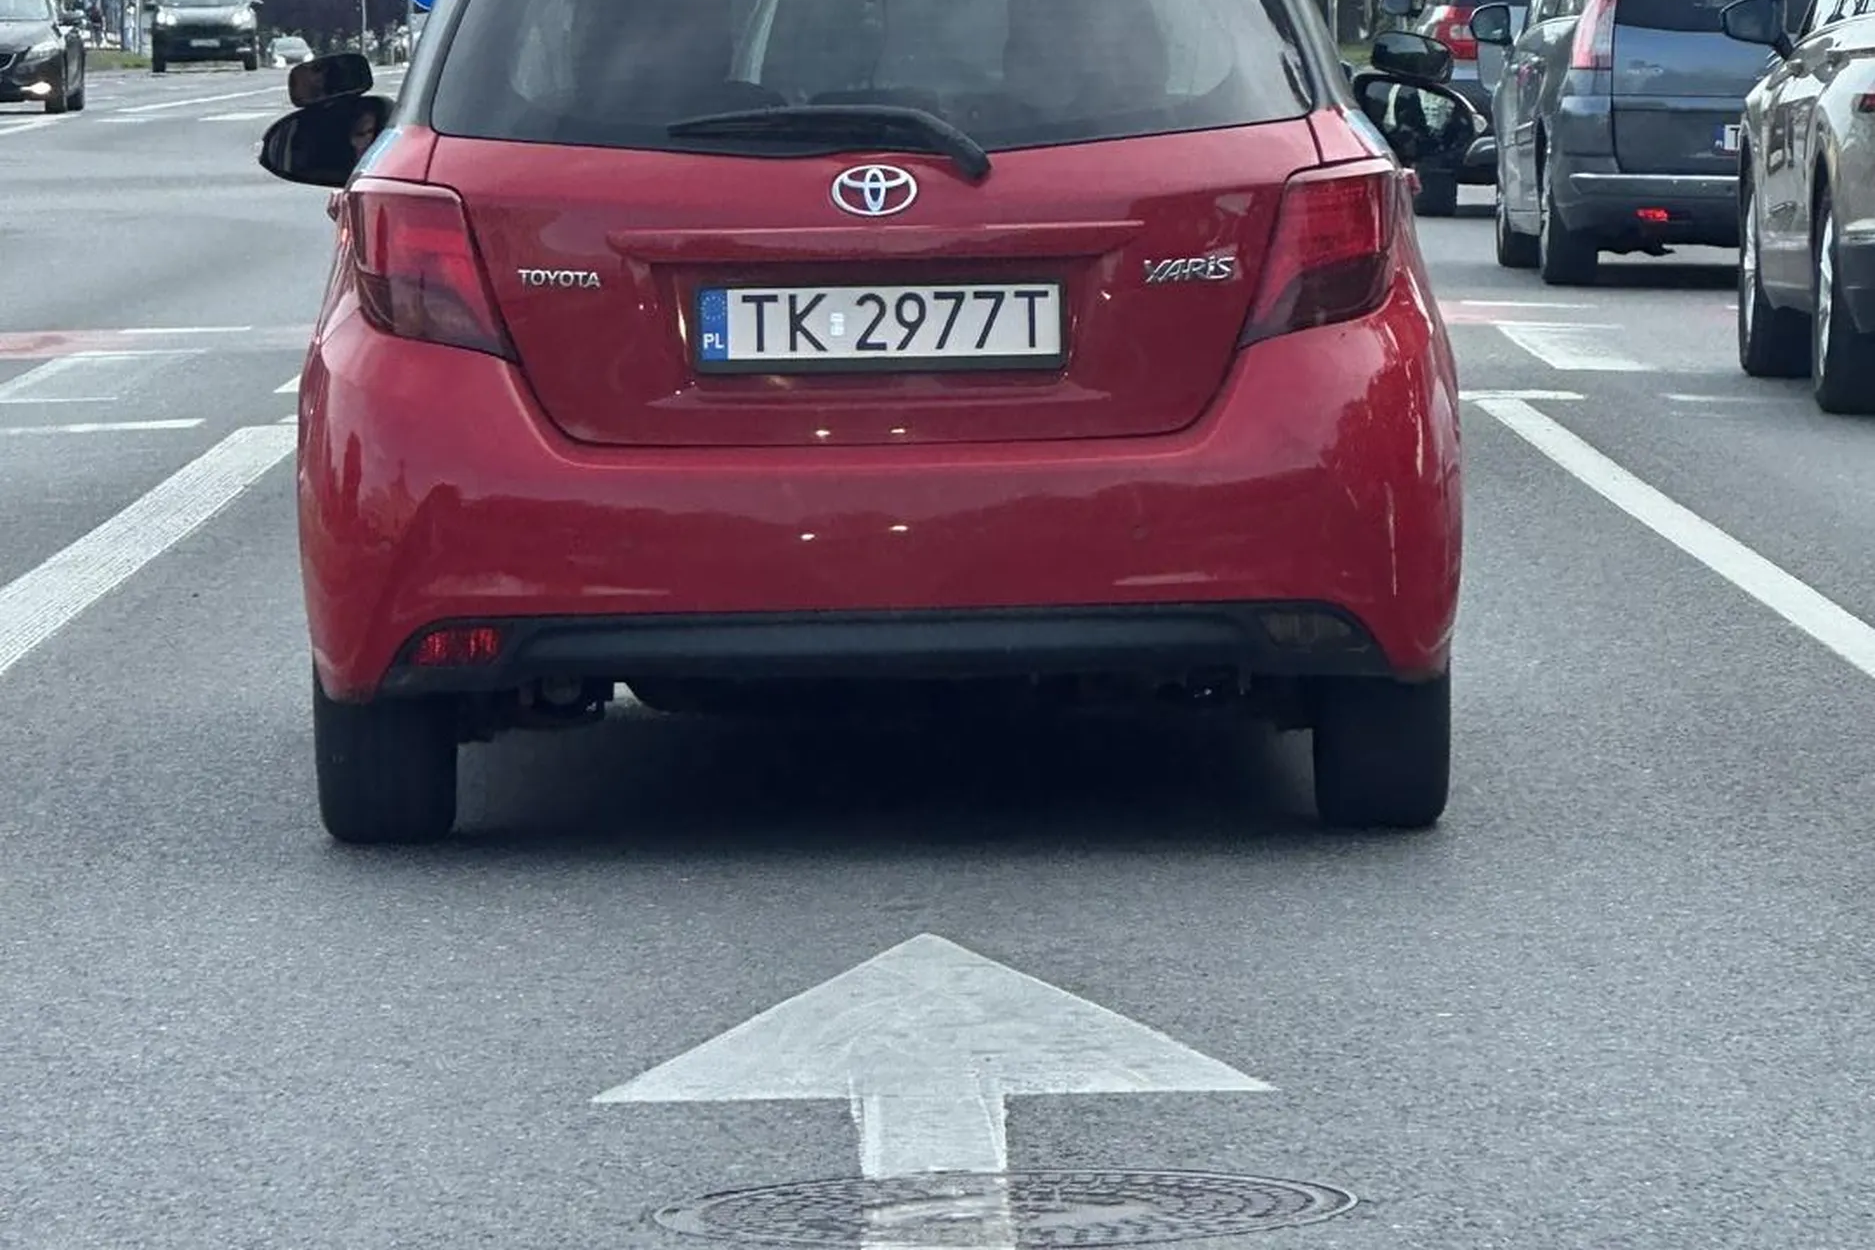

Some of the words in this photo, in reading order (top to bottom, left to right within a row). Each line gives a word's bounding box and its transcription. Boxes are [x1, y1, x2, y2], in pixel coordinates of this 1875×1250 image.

[518, 269, 601, 288] TOYOTA
[741, 293, 828, 353] TK
[855, 290, 1049, 351] 2977T
[702, 333, 725, 349] PL
